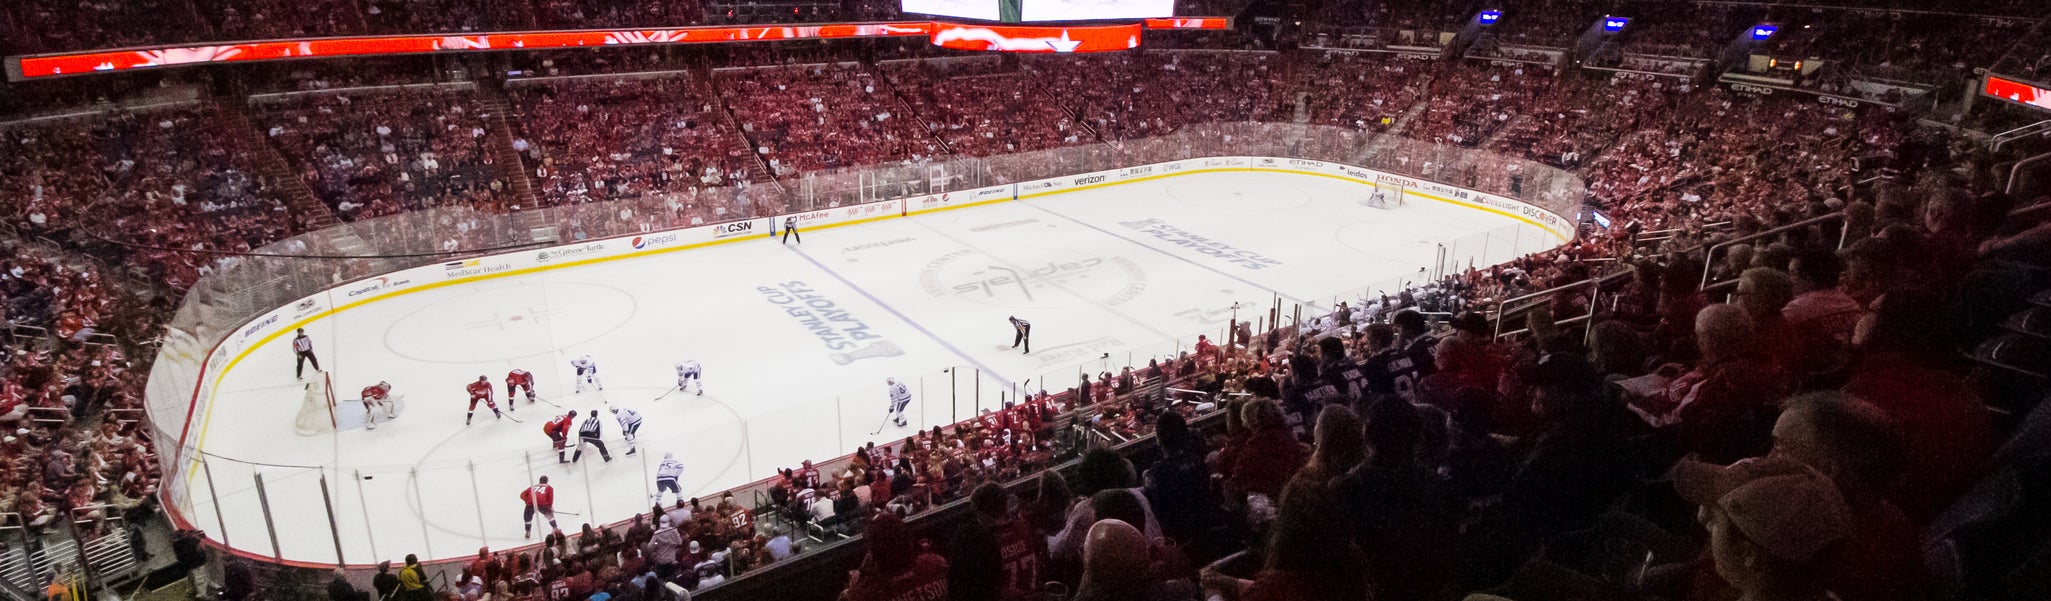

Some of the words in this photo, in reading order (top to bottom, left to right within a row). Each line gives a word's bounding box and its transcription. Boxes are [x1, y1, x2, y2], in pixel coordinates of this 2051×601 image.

[1731, 83, 1773, 95] ETIHAD
[1818, 95, 1858, 108] ETIHAD
[1168, 163, 1182, 171] WGL
[1289, 160, 1324, 168] ETIHAD
[1347, 168, 1368, 179] leidos
[1074, 174, 1105, 186] verizon
[1377, 174, 1418, 188] HONDA
[978, 188, 1005, 196] BOEING
[1502, 202, 1520, 212] LIGHT
[799, 211, 829, 222] McAfee
[728, 221, 752, 233] CSN
[647, 233, 677, 245] pepsi
[1140, 229, 1270, 270] PLAYOFFS
[447, 267, 482, 279] MedStar
[483, 263, 512, 274] Health
[348, 284, 379, 297] Capital
[756, 286, 795, 305] CUP
[777, 280, 883, 340] PLAYOFFS
[244, 314, 279, 338] BOEING
[779, 306, 858, 350] STANLEY
[732, 513, 748, 529] 92
